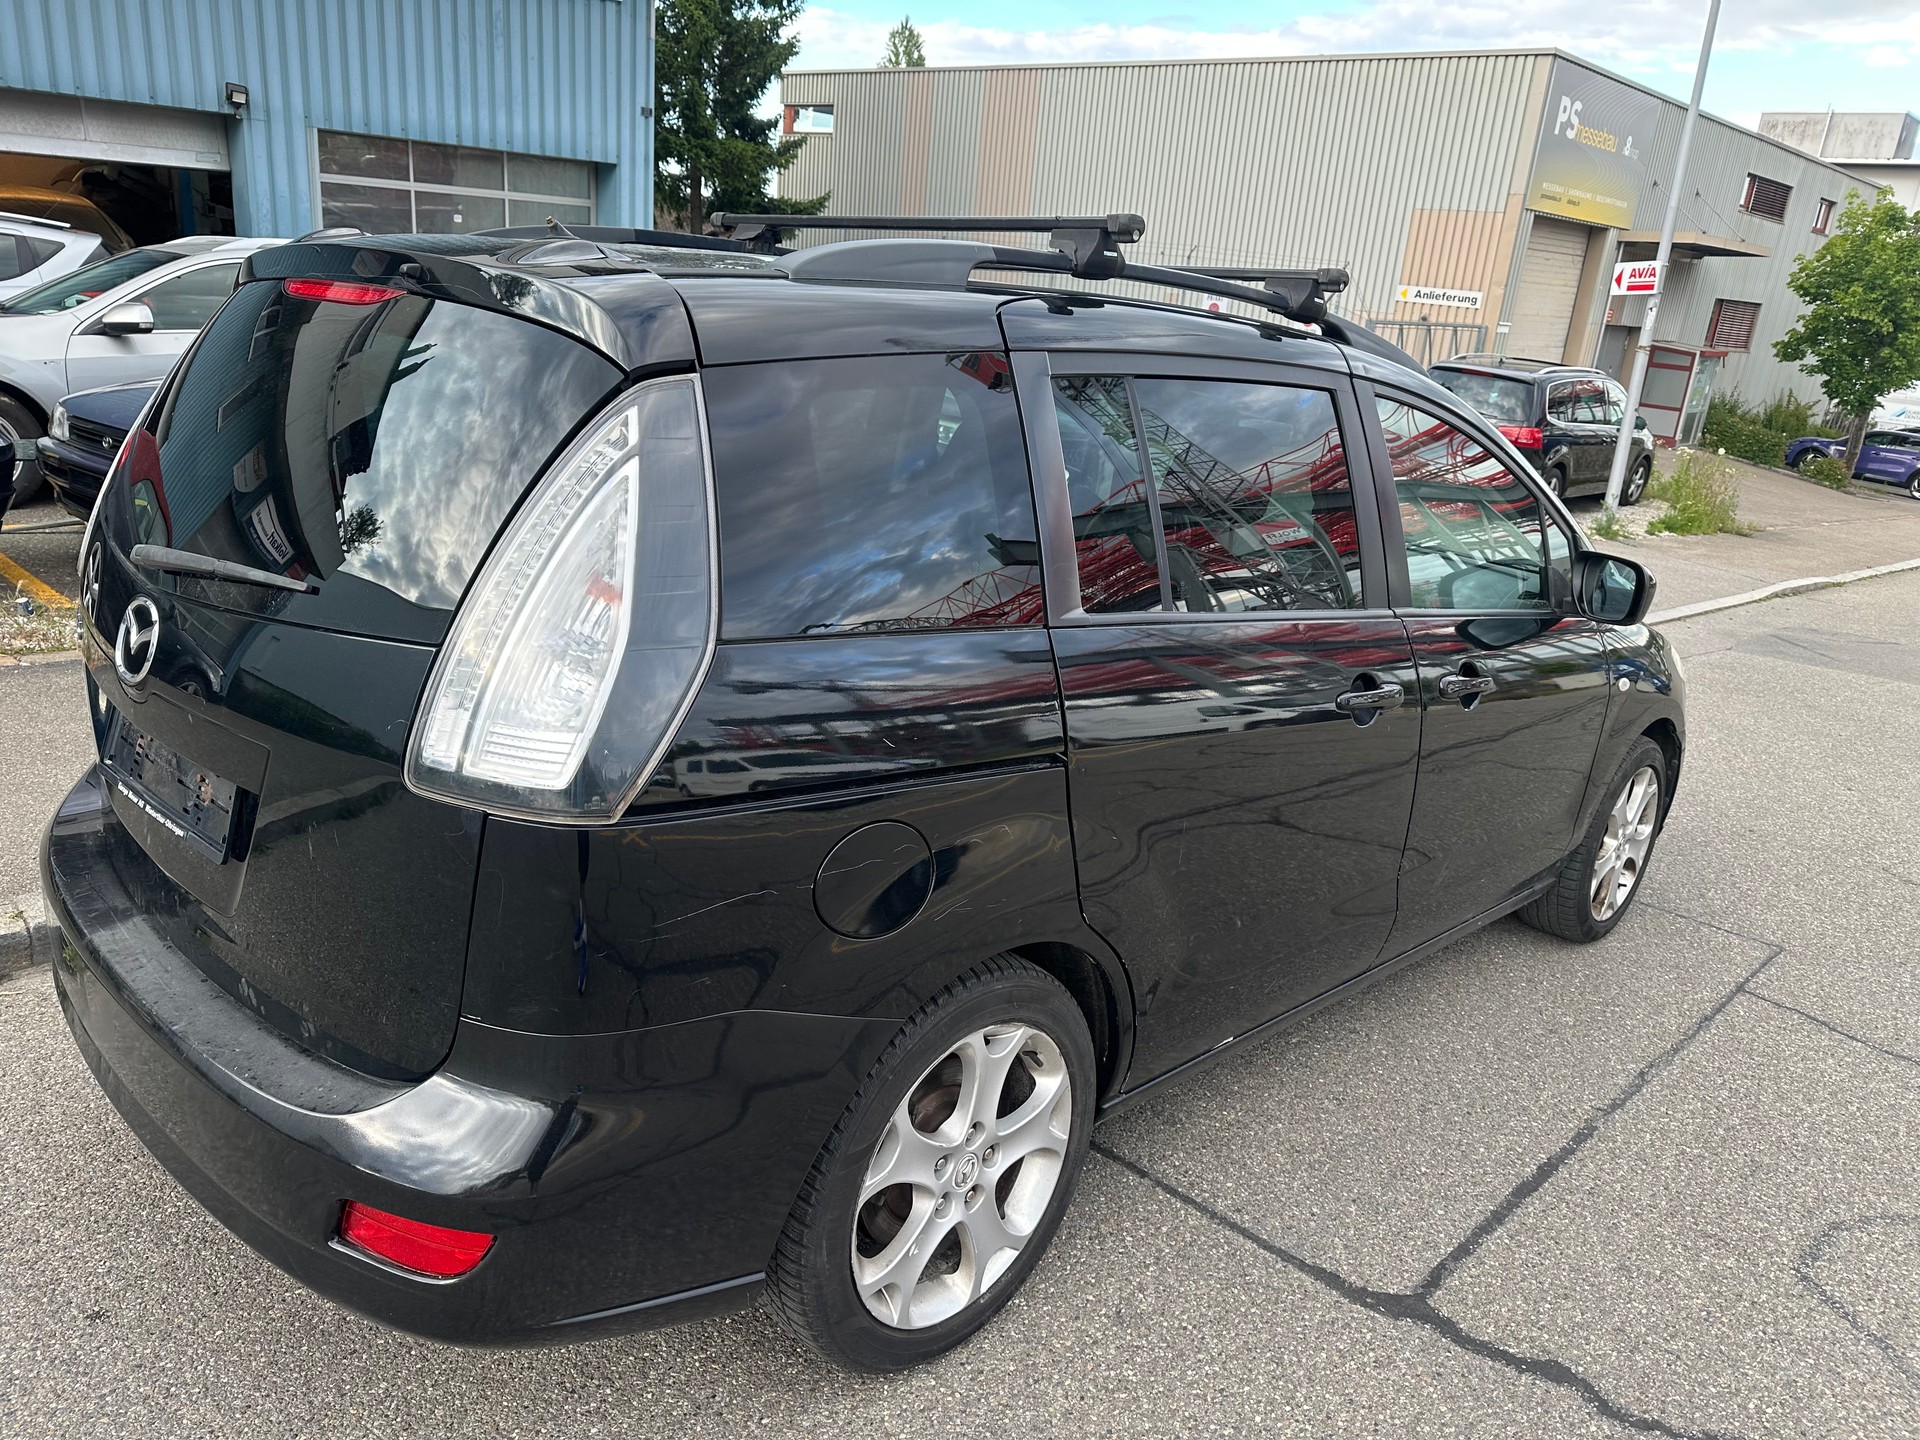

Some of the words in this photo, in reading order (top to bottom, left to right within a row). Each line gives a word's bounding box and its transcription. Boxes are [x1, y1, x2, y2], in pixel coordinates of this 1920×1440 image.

[1554, 95, 1583, 139] PS
[1628, 264, 1657, 279] AVIA
[1414, 290, 1478, 306] Anlieferung
